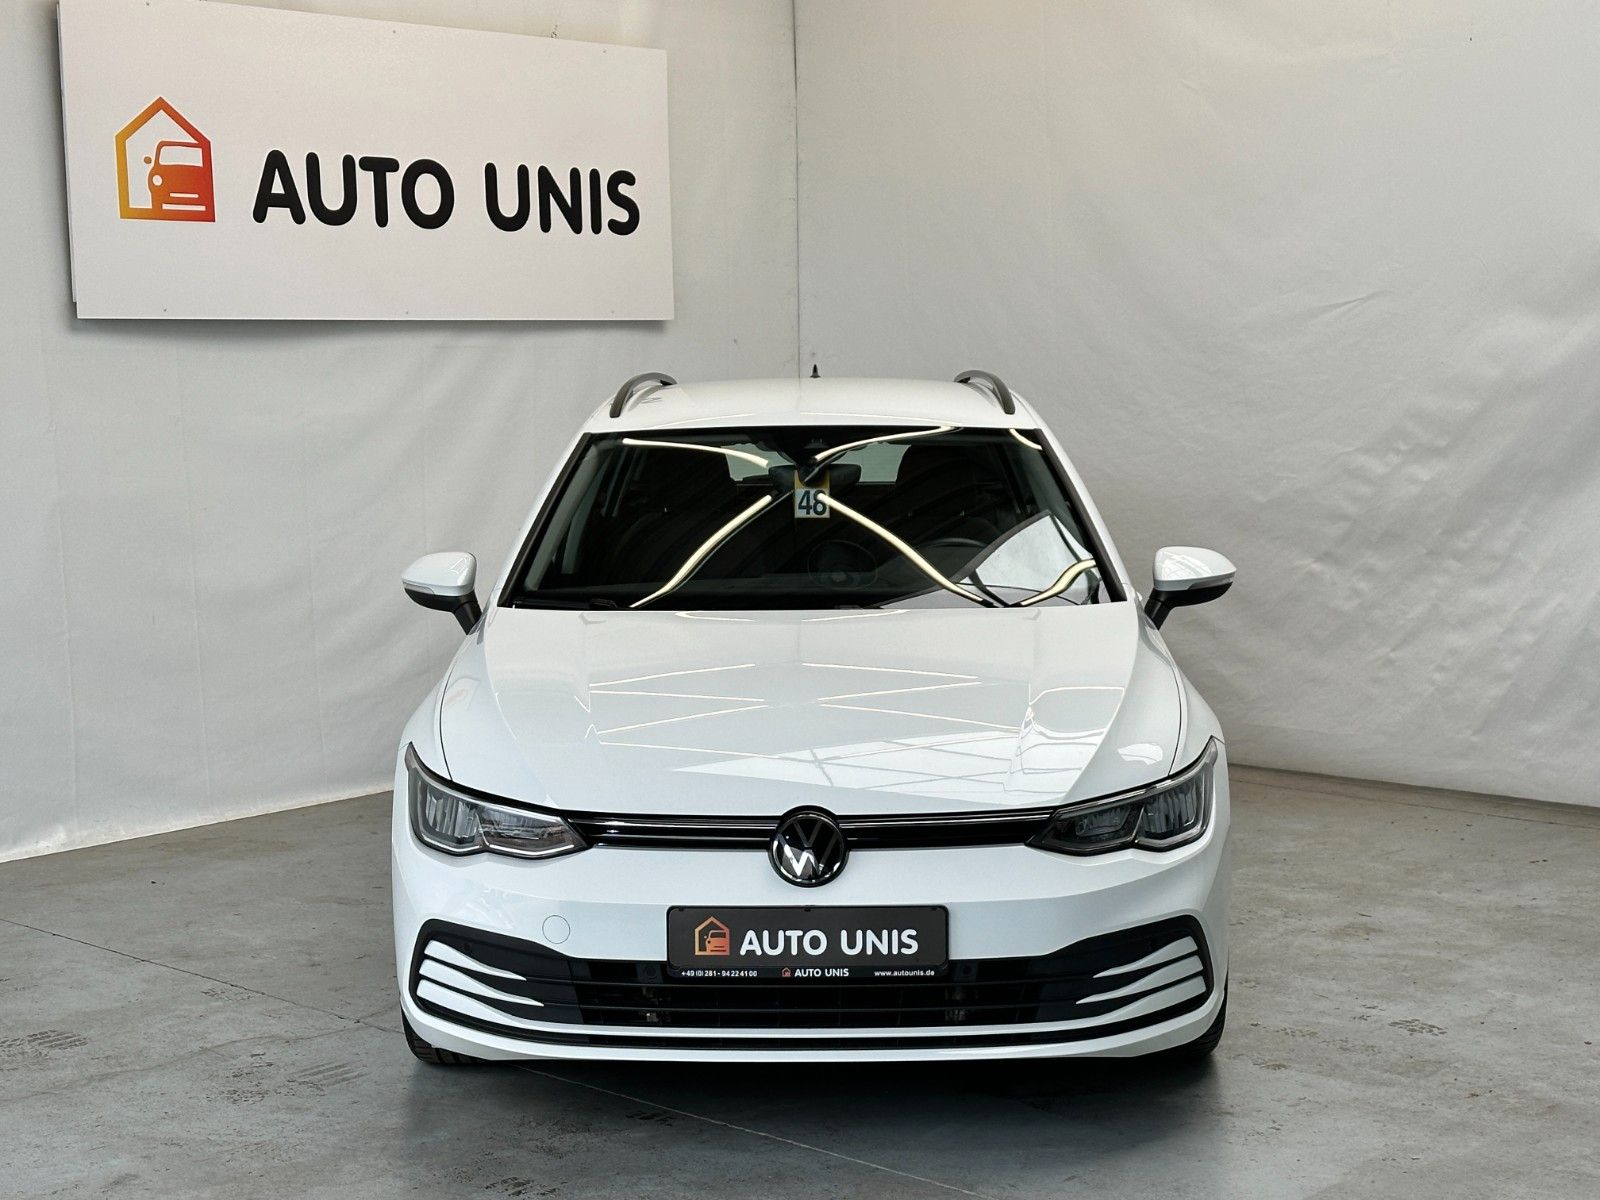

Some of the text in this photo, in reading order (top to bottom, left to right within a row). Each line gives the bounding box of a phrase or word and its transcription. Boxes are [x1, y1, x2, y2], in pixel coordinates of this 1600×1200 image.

[252, 149, 640, 236] AUTO UNIS
[739, 928, 919, 956] AUTO UNIS
[681, 969, 695, 977] +49
[704, 969, 717, 977] 281
[794, 968, 850, 977] AUTO UNIS
[873, 969, 935, 977] www.autounis.de
